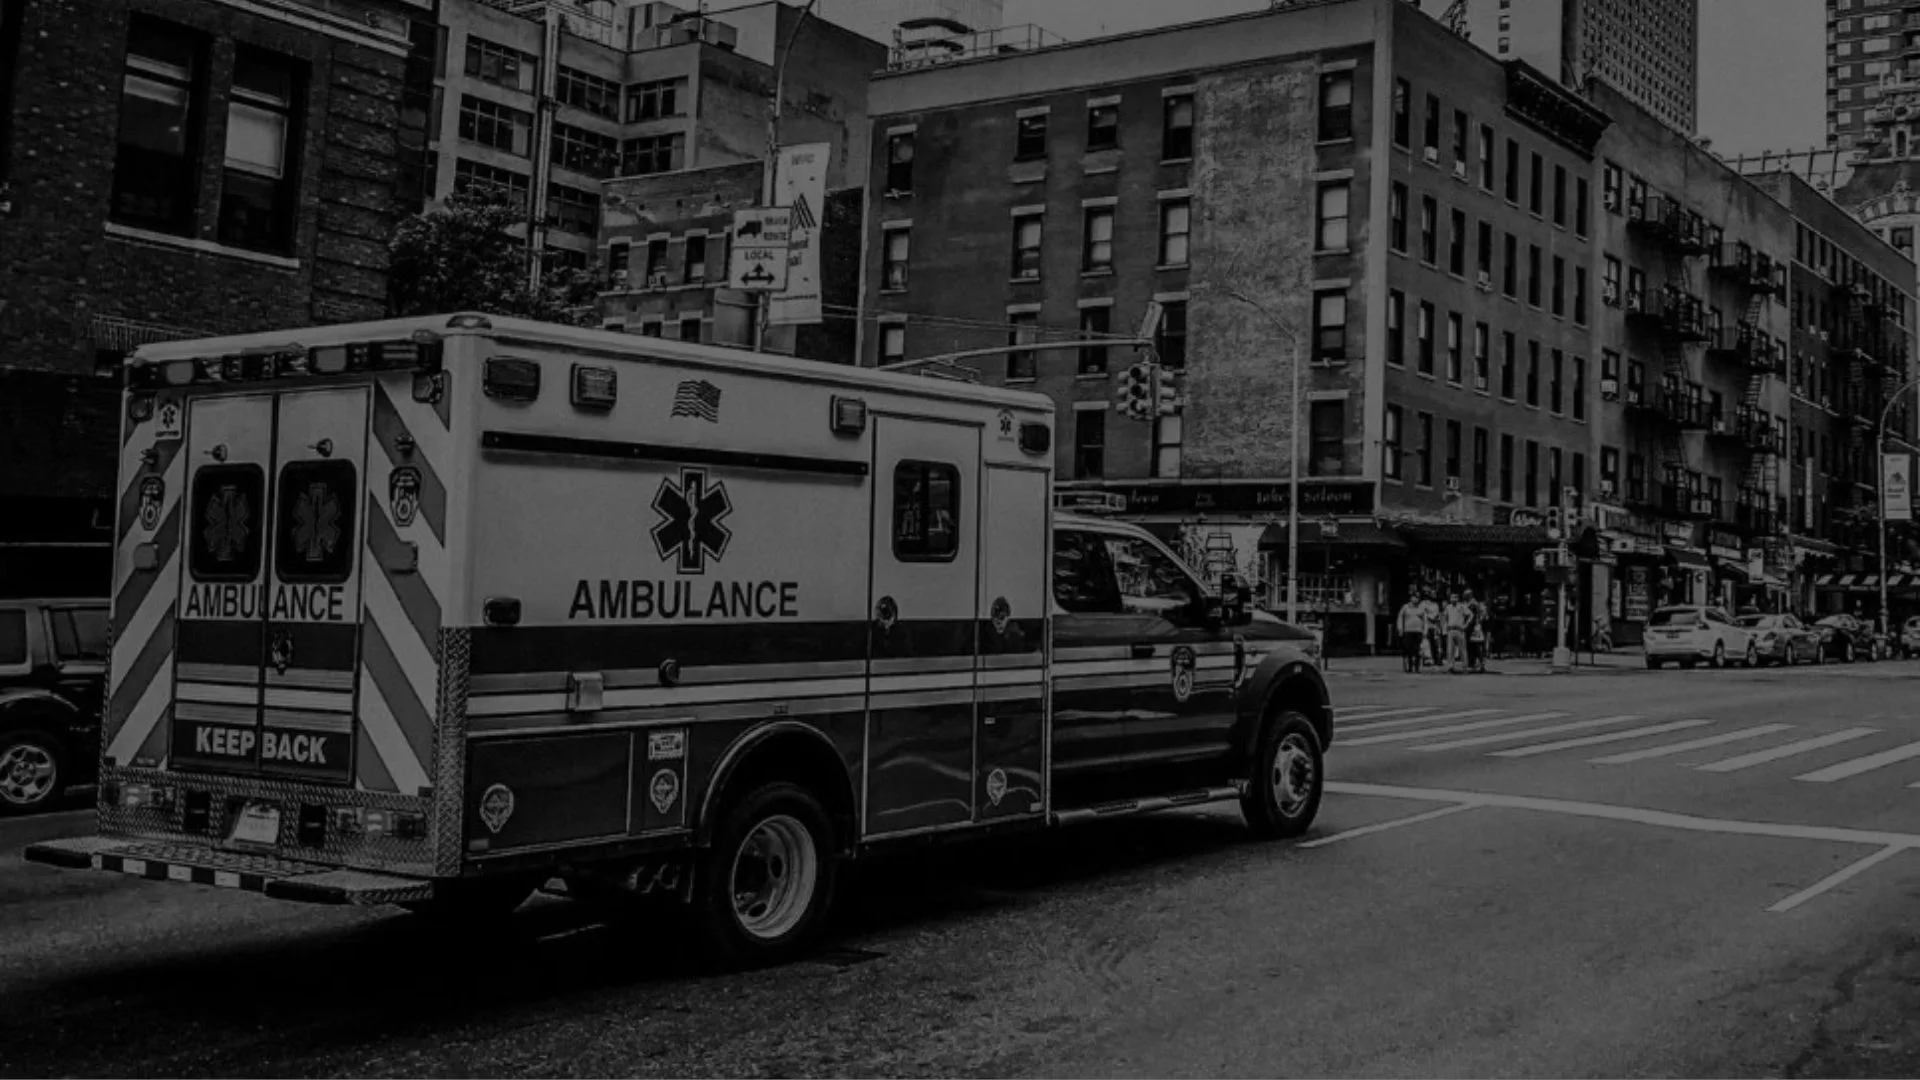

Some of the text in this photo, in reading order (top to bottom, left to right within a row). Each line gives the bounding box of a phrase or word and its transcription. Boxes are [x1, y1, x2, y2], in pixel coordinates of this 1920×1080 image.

[744, 249, 774, 261] LOCAL
[186, 584, 344, 620] AMBULANCE
[569, 580, 798, 618] AMBULANCE
[196, 726, 327, 764] KEEP BACK
